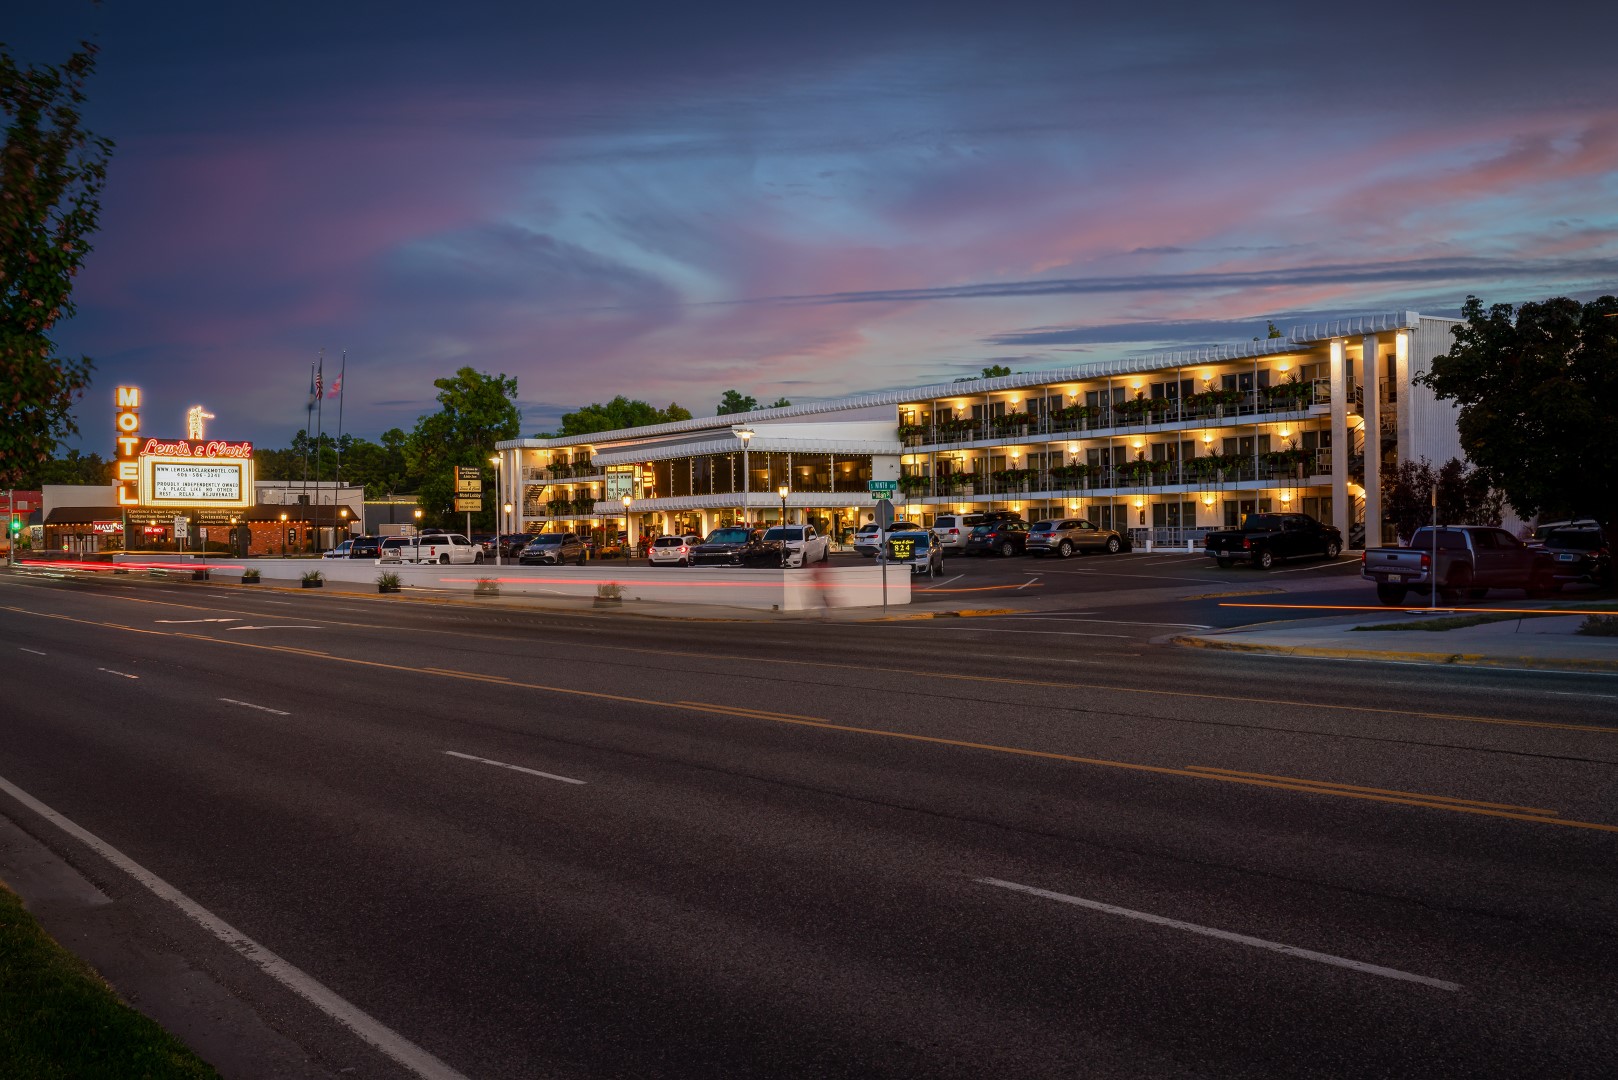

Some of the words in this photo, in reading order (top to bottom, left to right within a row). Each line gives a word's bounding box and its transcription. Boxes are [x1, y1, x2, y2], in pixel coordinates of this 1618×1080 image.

[118, 388, 138, 504] MOTEL
[140, 439, 191, 456] Lewis
[206, 441, 251, 458] Clark
